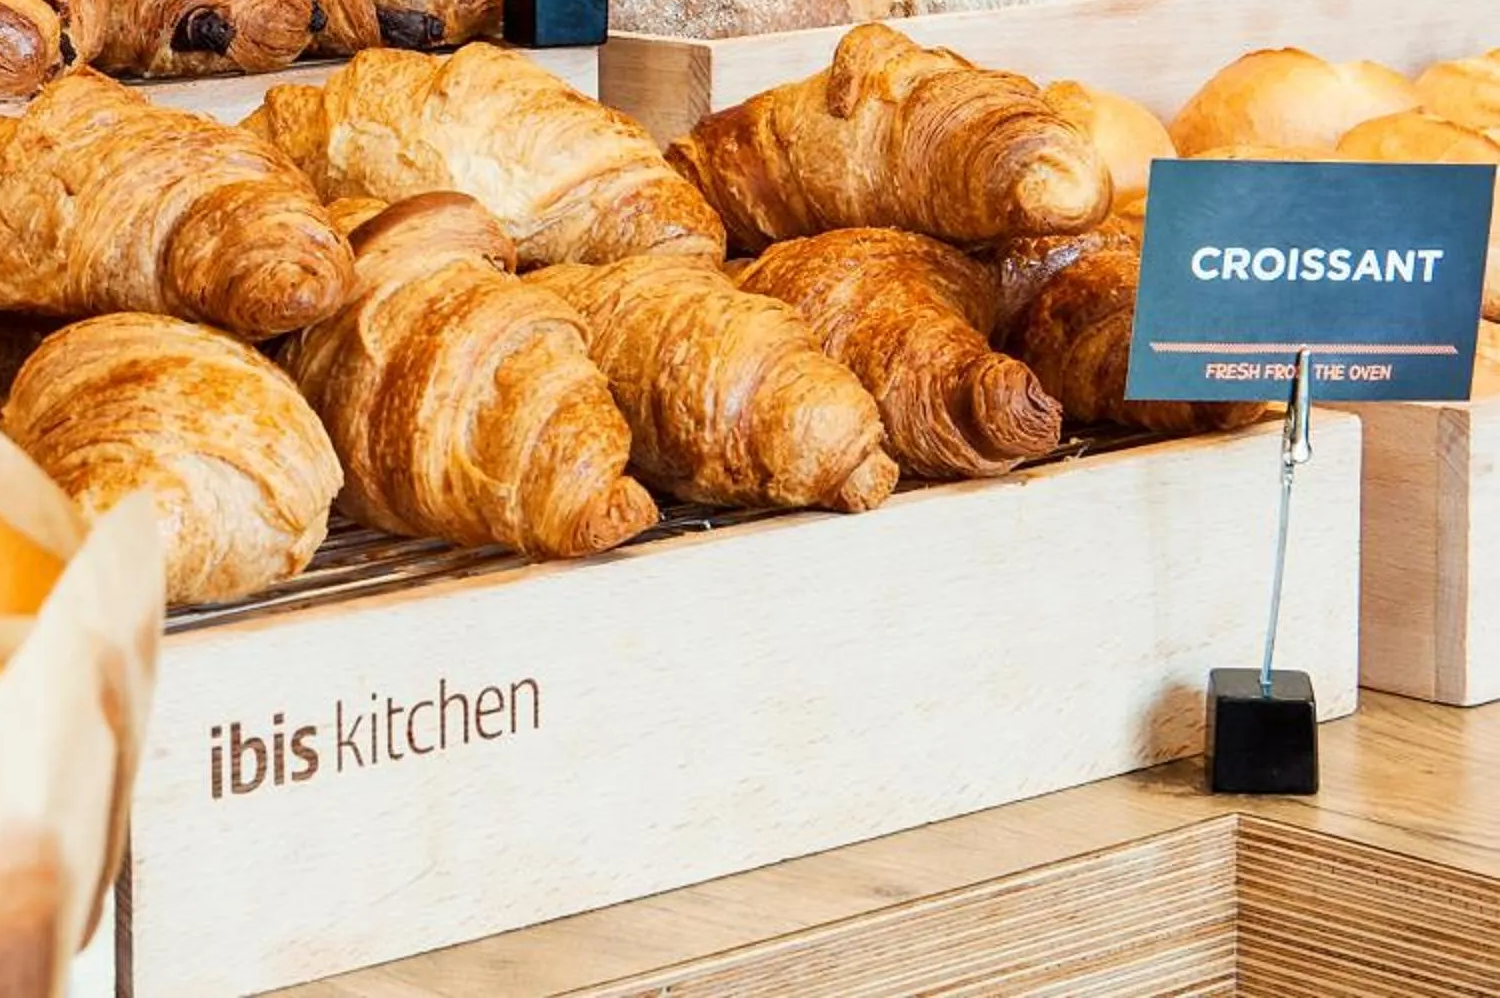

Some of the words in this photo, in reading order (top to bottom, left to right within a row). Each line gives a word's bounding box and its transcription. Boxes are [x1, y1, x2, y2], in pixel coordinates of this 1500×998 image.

[1191, 246, 1445, 283] CROISSANT
[1205, 362, 1260, 380] FRESH
[1264, 363, 1303, 381] FRO
[1314, 363, 1346, 381] THE
[1350, 363, 1393, 381] OVEN
[210, 712, 319, 800] ibis
[336, 677, 540, 773] kitchen
